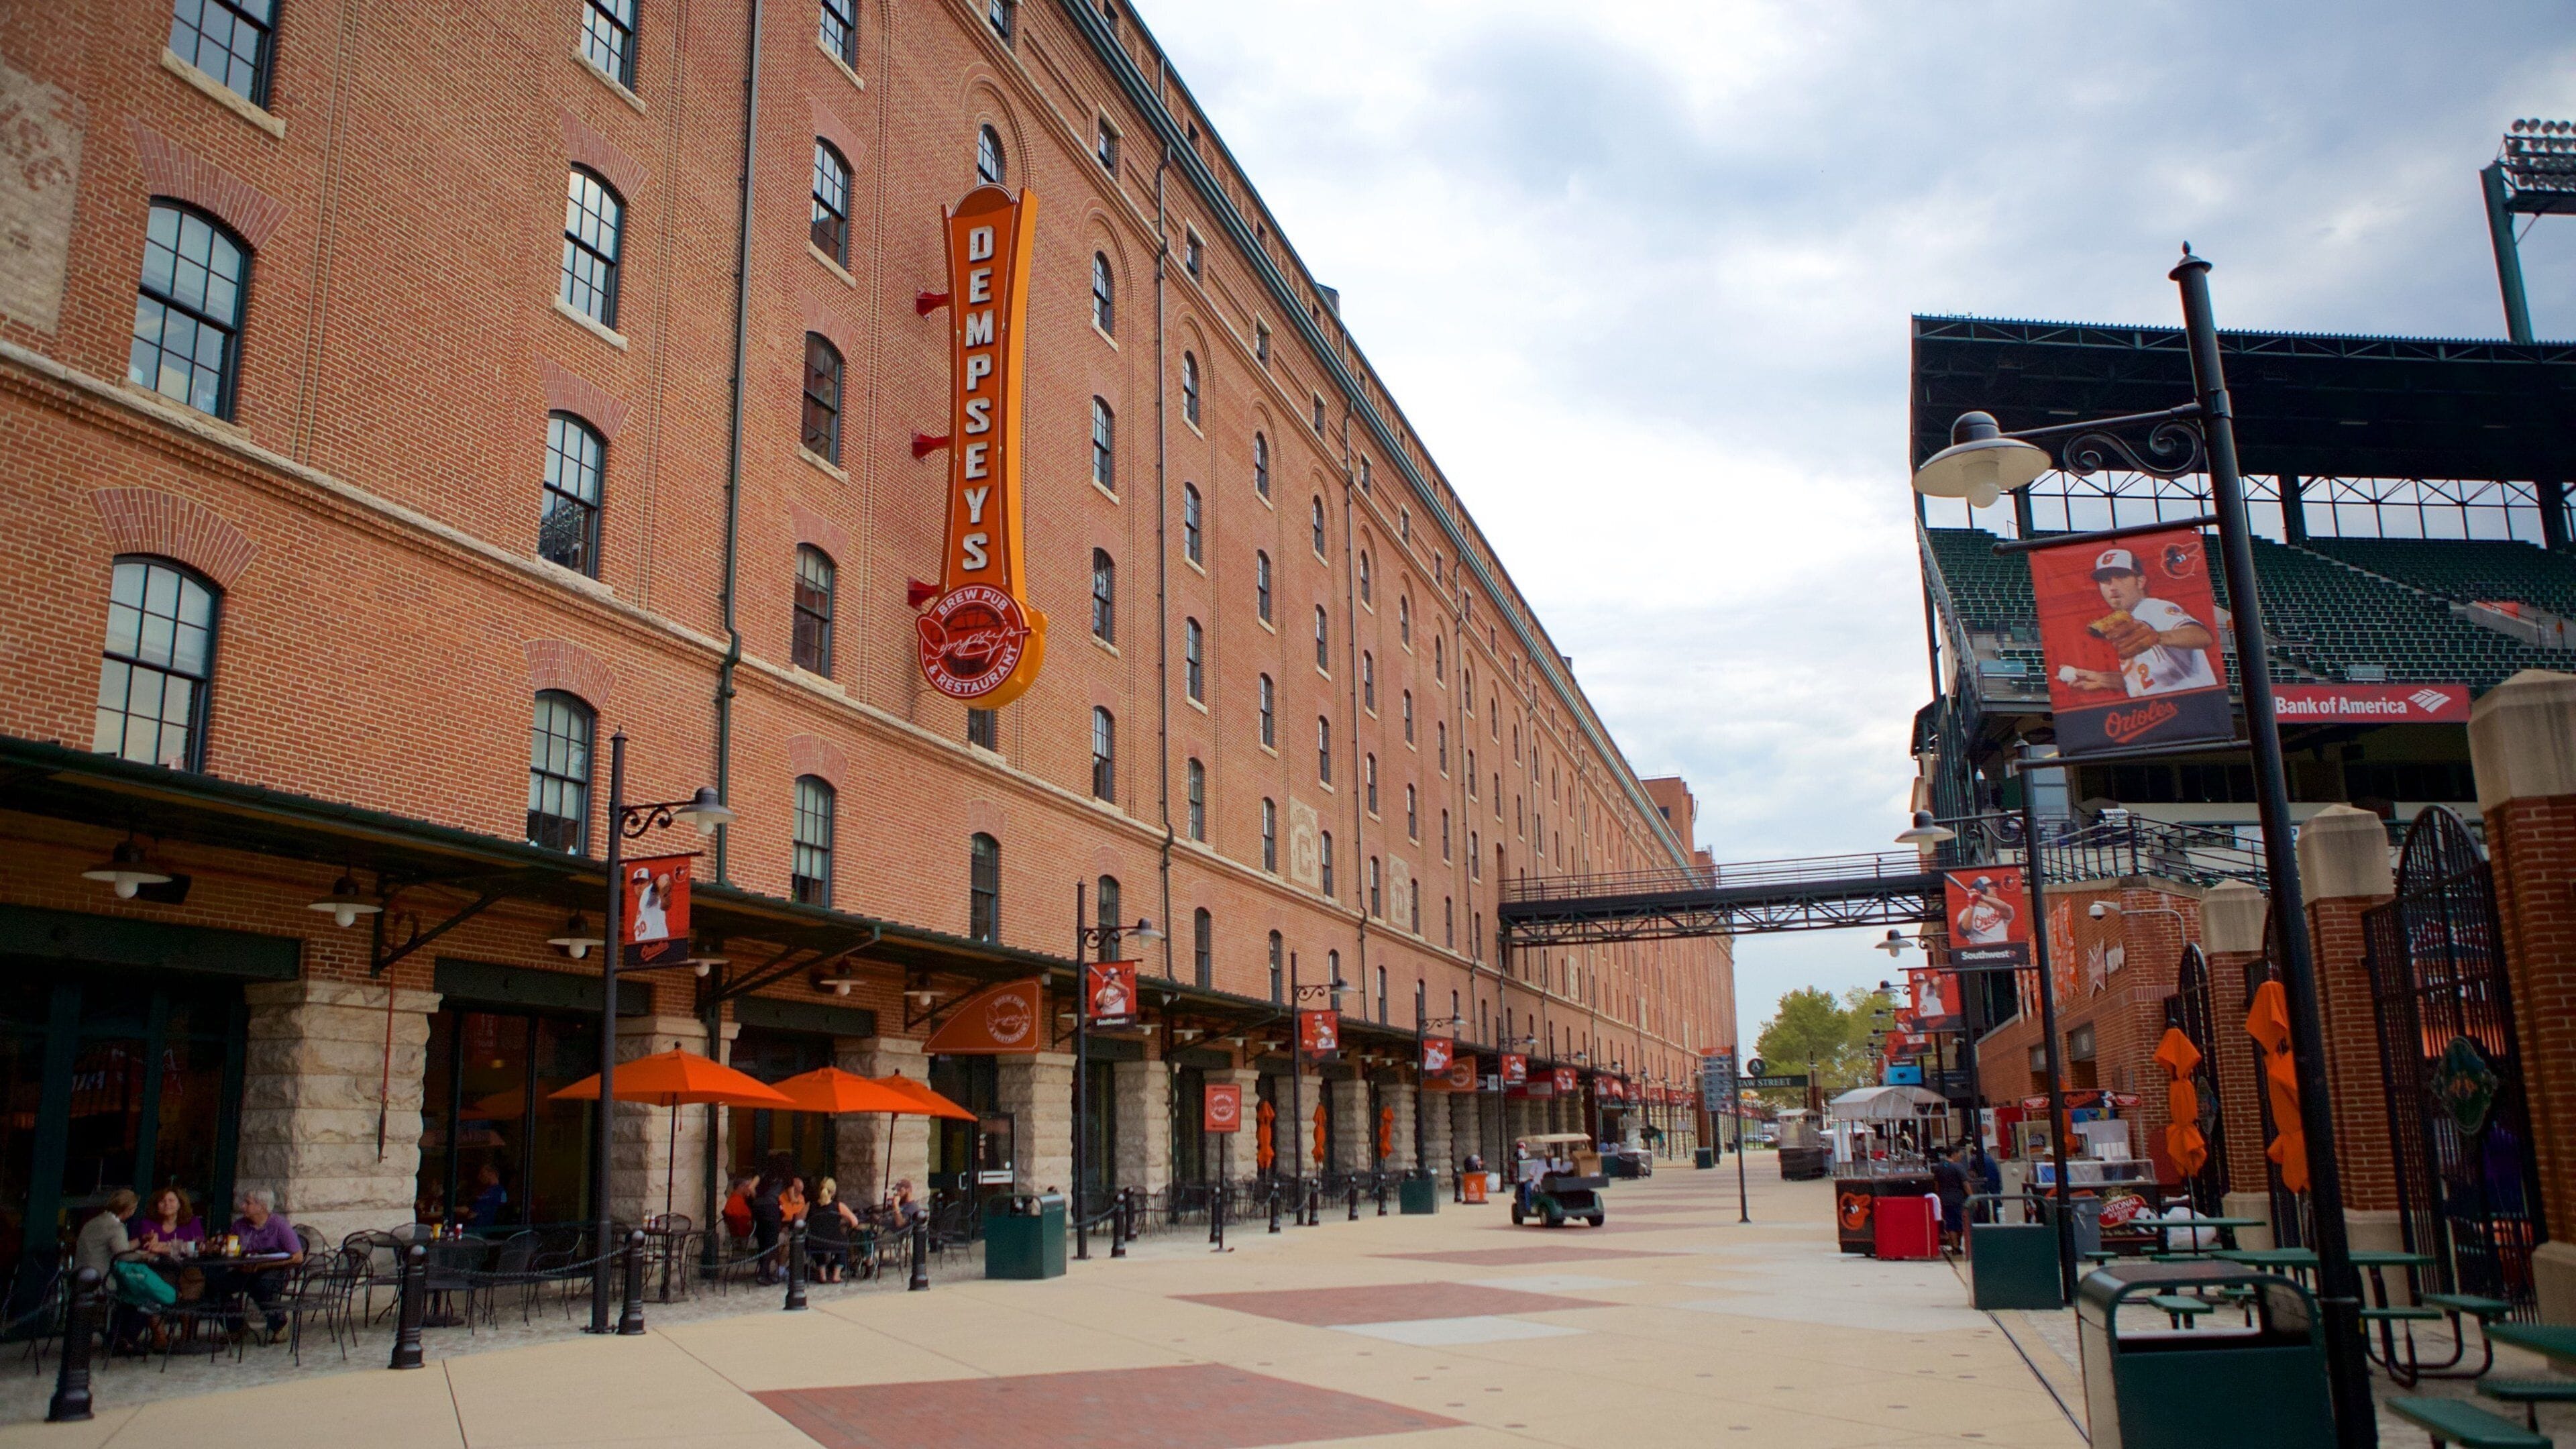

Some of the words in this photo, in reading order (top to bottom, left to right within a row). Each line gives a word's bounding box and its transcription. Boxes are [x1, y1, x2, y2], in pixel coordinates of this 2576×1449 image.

[962, 225, 994, 572] DEMPSEYS
[938, 589, 977, 616] BREW
[981, 591, 1008, 611] PUB
[928, 665, 938, 676] &
[936, 645, 1018, 694] RESTAURANT
[2275, 696, 2318, 714] Bank
[2319, 696, 2336, 714] of
[2339, 696, 2408, 714] America
[2105, 700, 2180, 743] Orioles
[1961, 950, 2010, 960] Southwest
[1752, 1061, 1761, 1070] A
[1737, 1077, 1756, 1087] TAW
[1757, 1077, 1791, 1087] STREET
